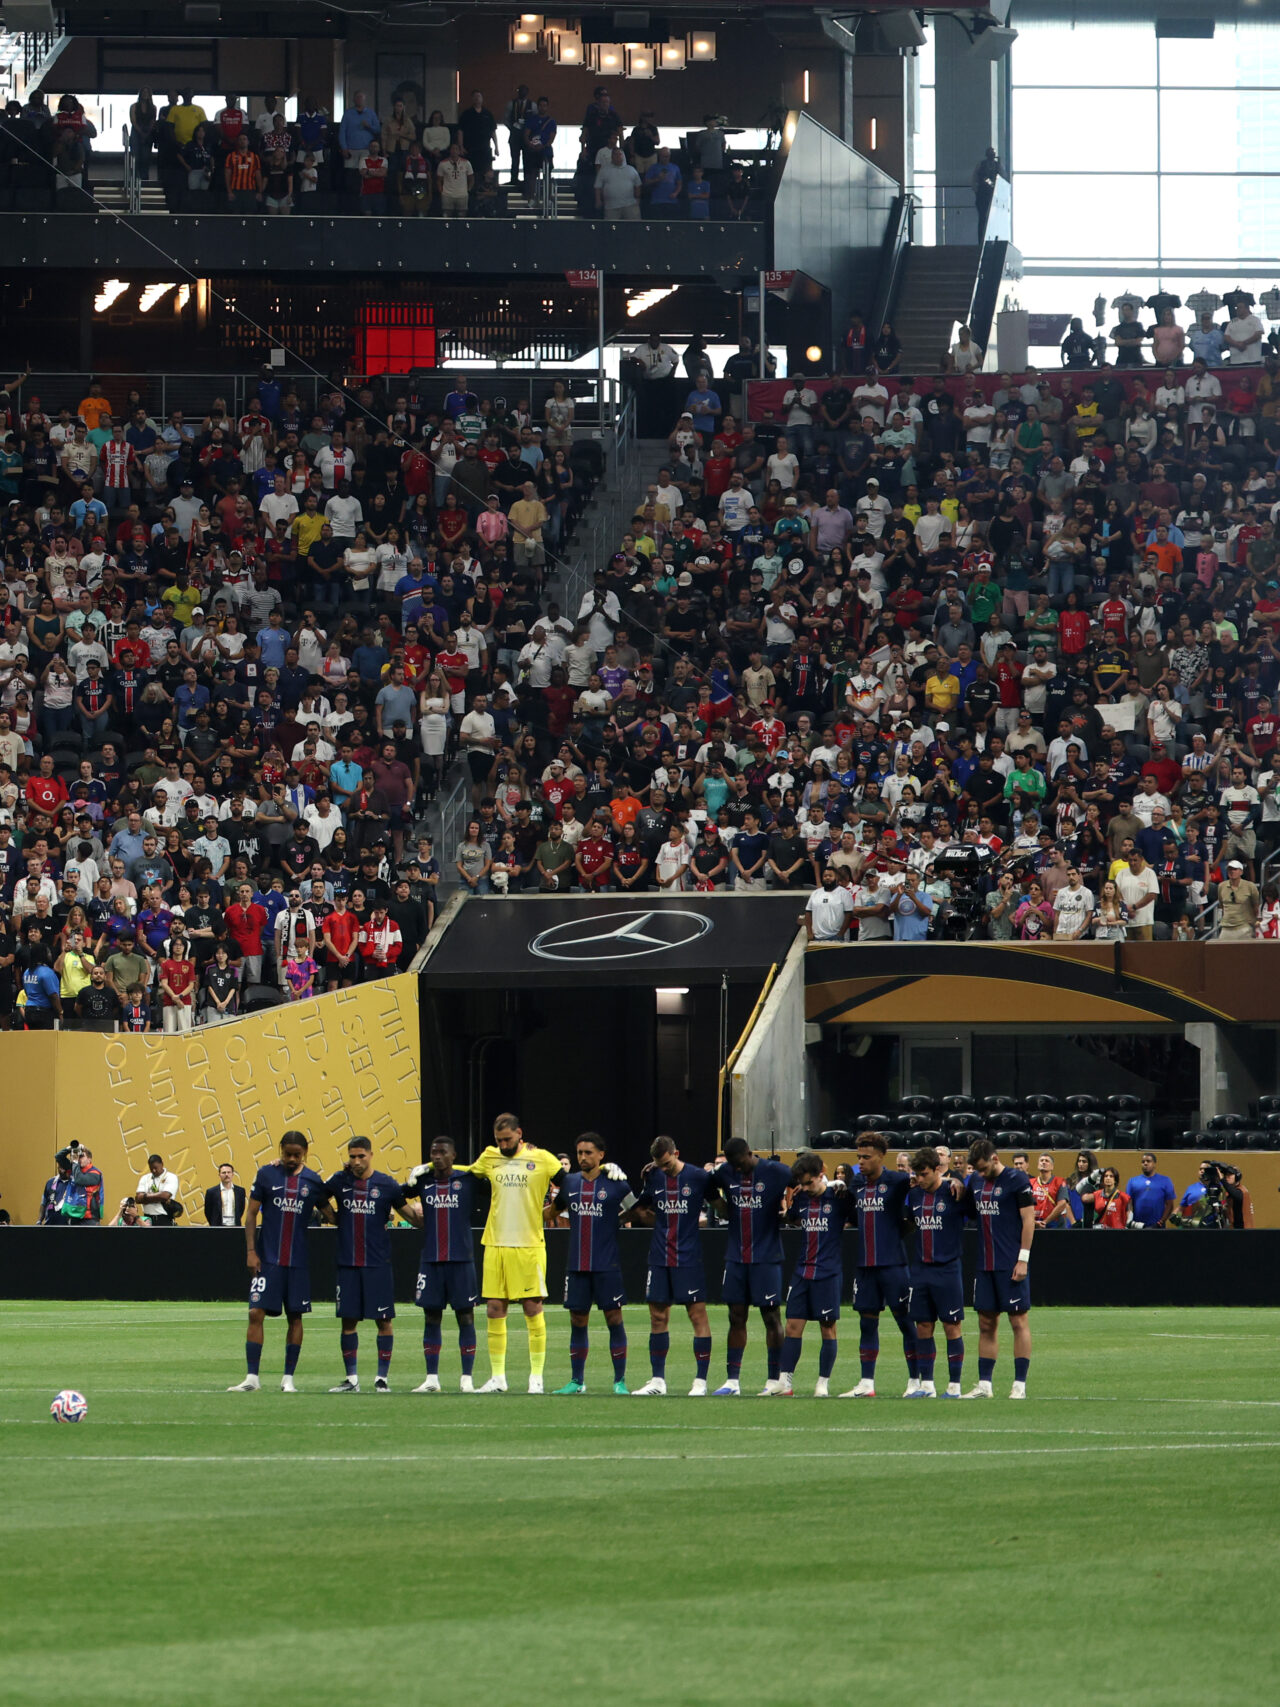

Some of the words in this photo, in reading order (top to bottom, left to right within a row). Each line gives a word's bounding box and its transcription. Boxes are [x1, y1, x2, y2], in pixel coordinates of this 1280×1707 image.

[578, 270, 597, 280] 134
[765, 271, 782, 281] 135
[42, 790, 56, 803] O2
[495, 1174, 528, 1183] QATAR
[273, 1196, 304, 1209] QATAR
[426, 1194, 458, 1204] QATAR
[657, 1199, 688, 1209] QATAR
[731, 1195, 762, 1205] QATAR
[857, 1196, 884, 1207] QATAR
[343, 1199, 375, 1210] QATAR
[570, 1202, 603, 1212] QATAR
[976, 1201, 999, 1211] QATAR
[800, 1217, 829, 1228] QATAR
[914, 1216, 942, 1226] QATAR
[250, 1277, 267, 1293] 29
